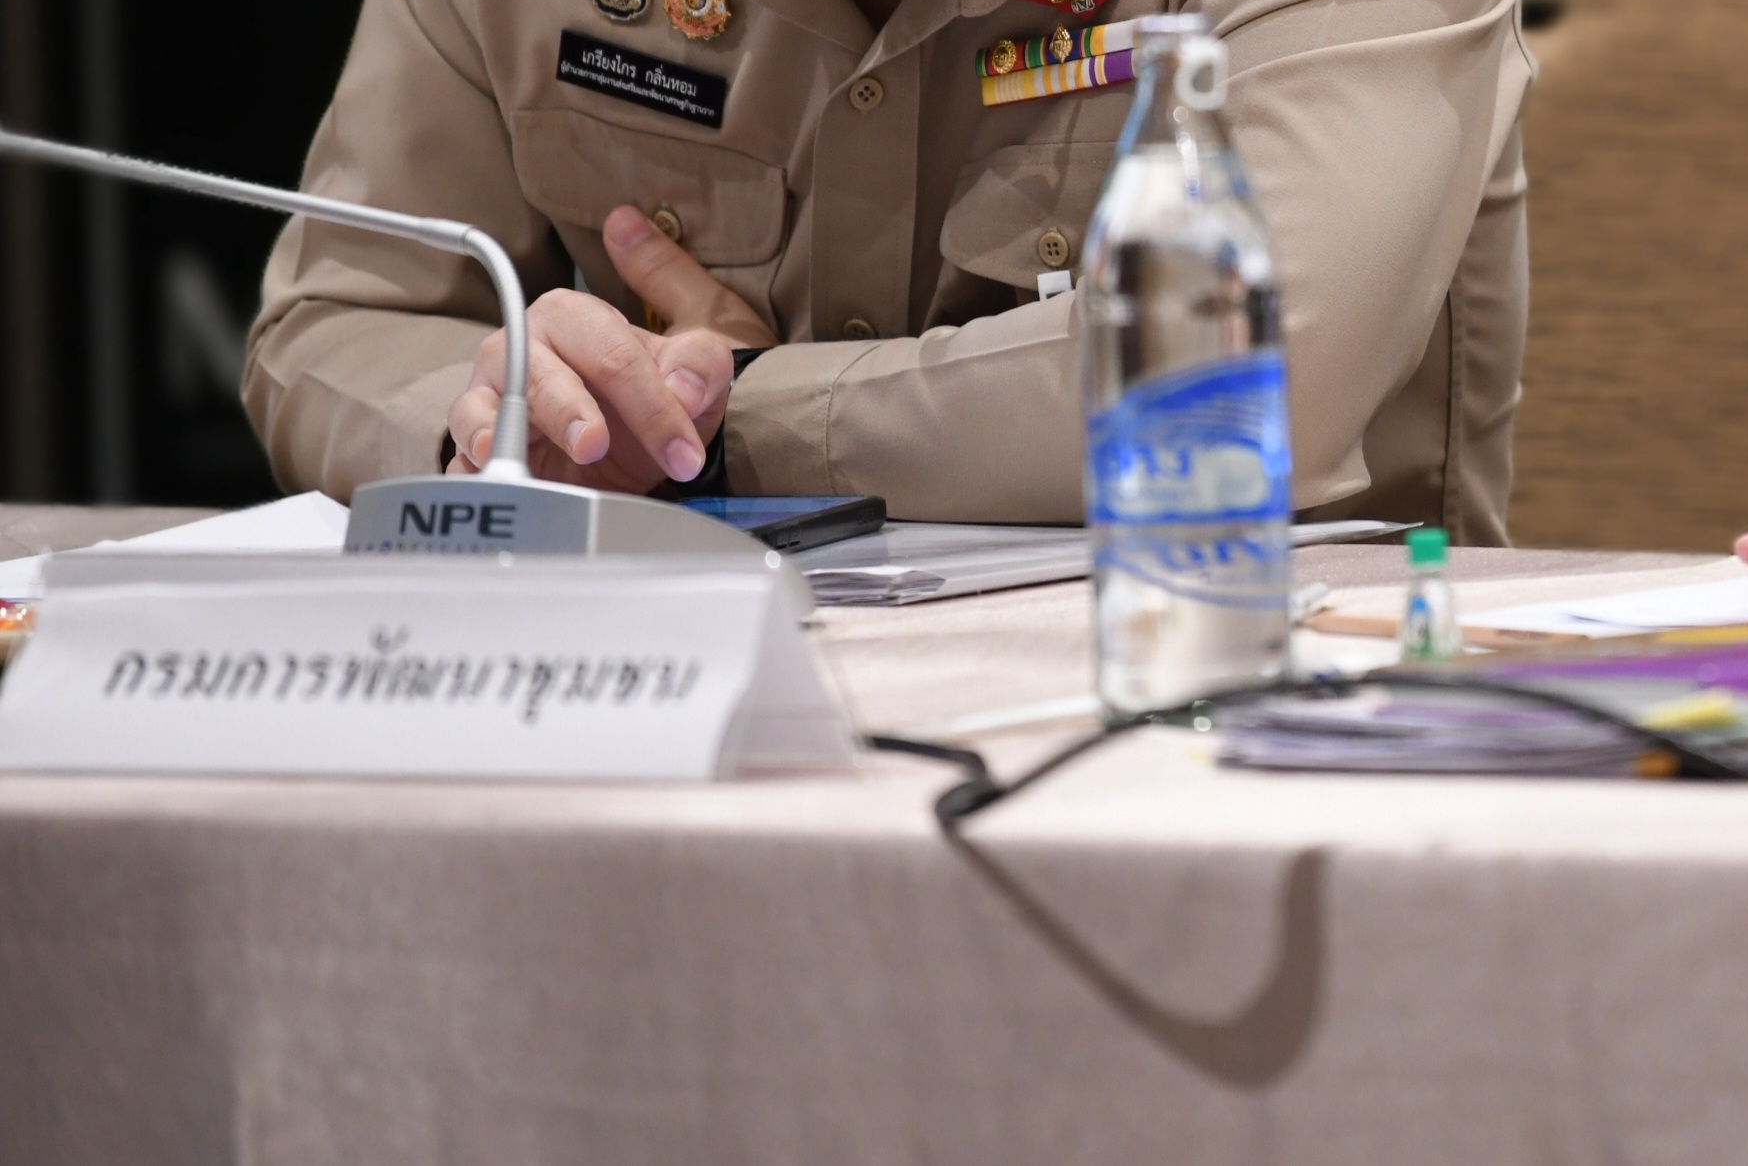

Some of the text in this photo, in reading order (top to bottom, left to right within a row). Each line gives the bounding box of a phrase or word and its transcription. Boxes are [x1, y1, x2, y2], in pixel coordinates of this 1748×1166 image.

[582, 48, 697, 97] เกรียงไกร กลิ่นหอม
[399, 501, 518, 539] NPE
[103, 624, 702, 726] กรมการพัฒนาชุมชน
